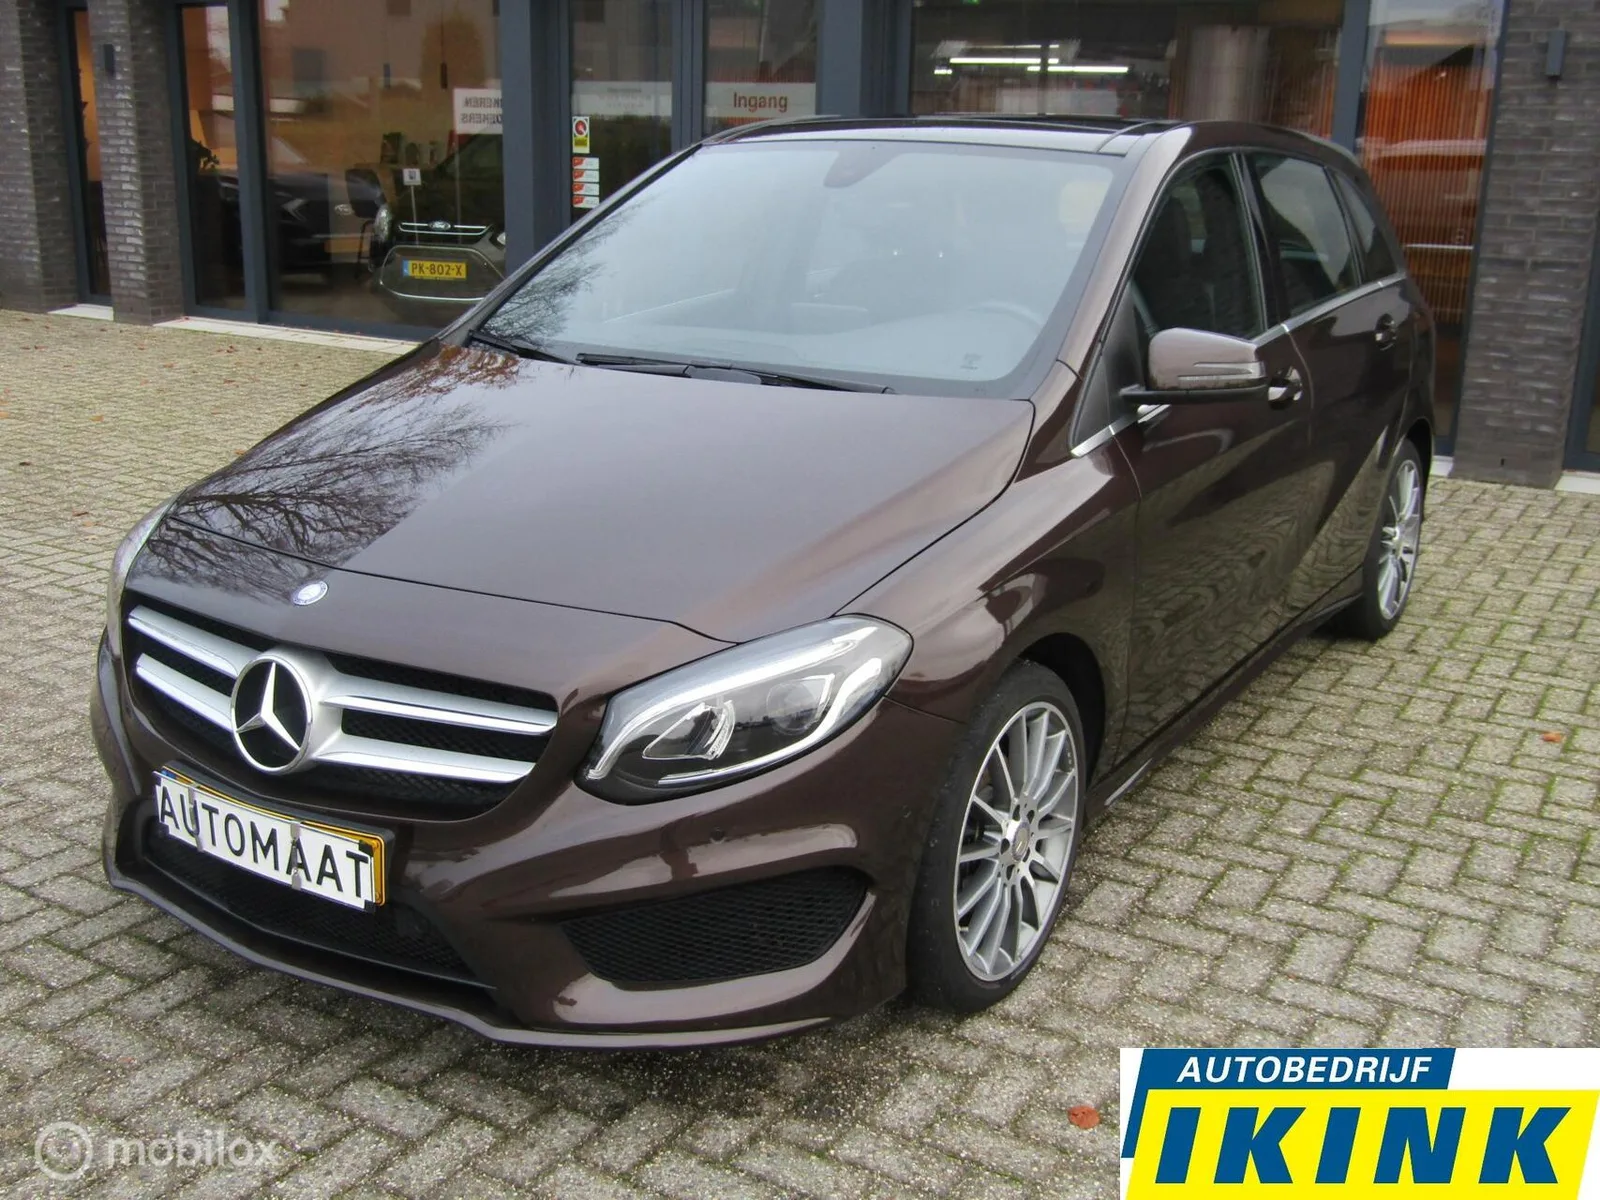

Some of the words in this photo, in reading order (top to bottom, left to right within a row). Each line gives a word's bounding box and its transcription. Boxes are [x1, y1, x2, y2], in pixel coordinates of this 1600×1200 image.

[733, 92, 788, 112] Ingang
[411, 262, 463, 276] PK-802-X
[159, 785, 370, 898] AUTOMAAT
